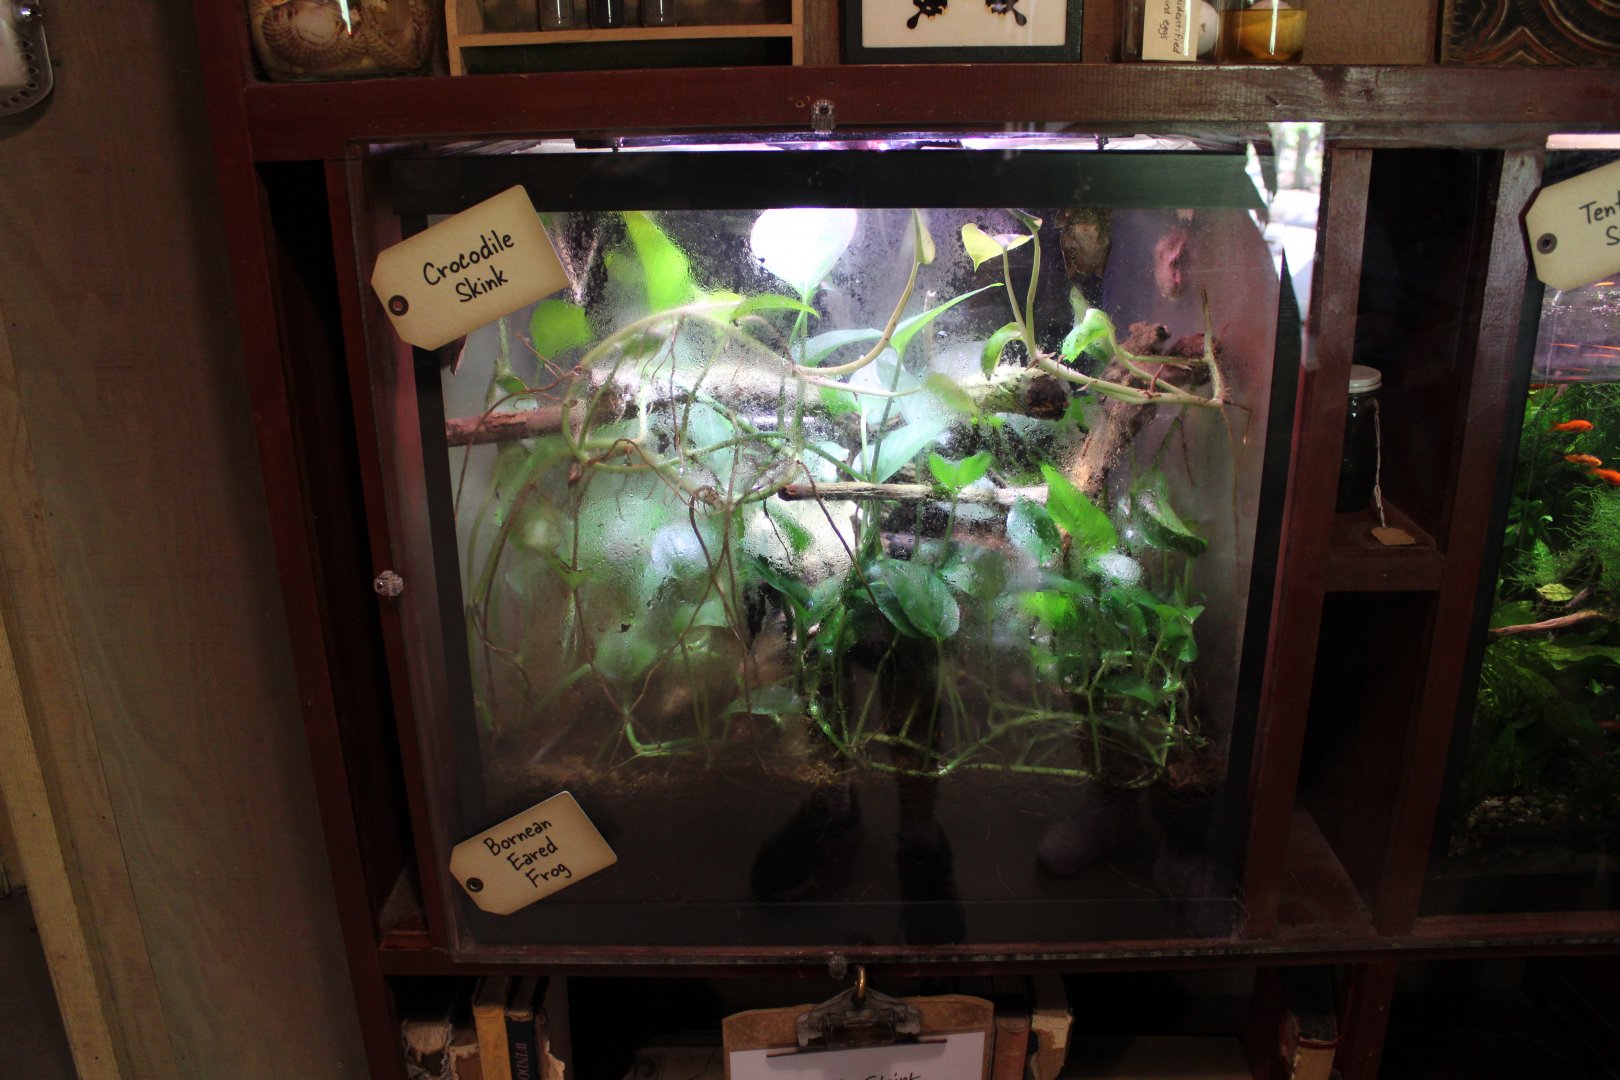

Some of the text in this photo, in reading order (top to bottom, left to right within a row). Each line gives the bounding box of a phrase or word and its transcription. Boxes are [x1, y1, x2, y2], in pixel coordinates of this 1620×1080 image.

[1158, 20, 1170, 40] eggs
[423, 230, 514, 285] Crocodile
[455, 265, 508, 303] Skink
[483, 820, 552, 856] Bornean
[506, 836, 559, 871] Eared
[525, 863, 572, 888] Frog
